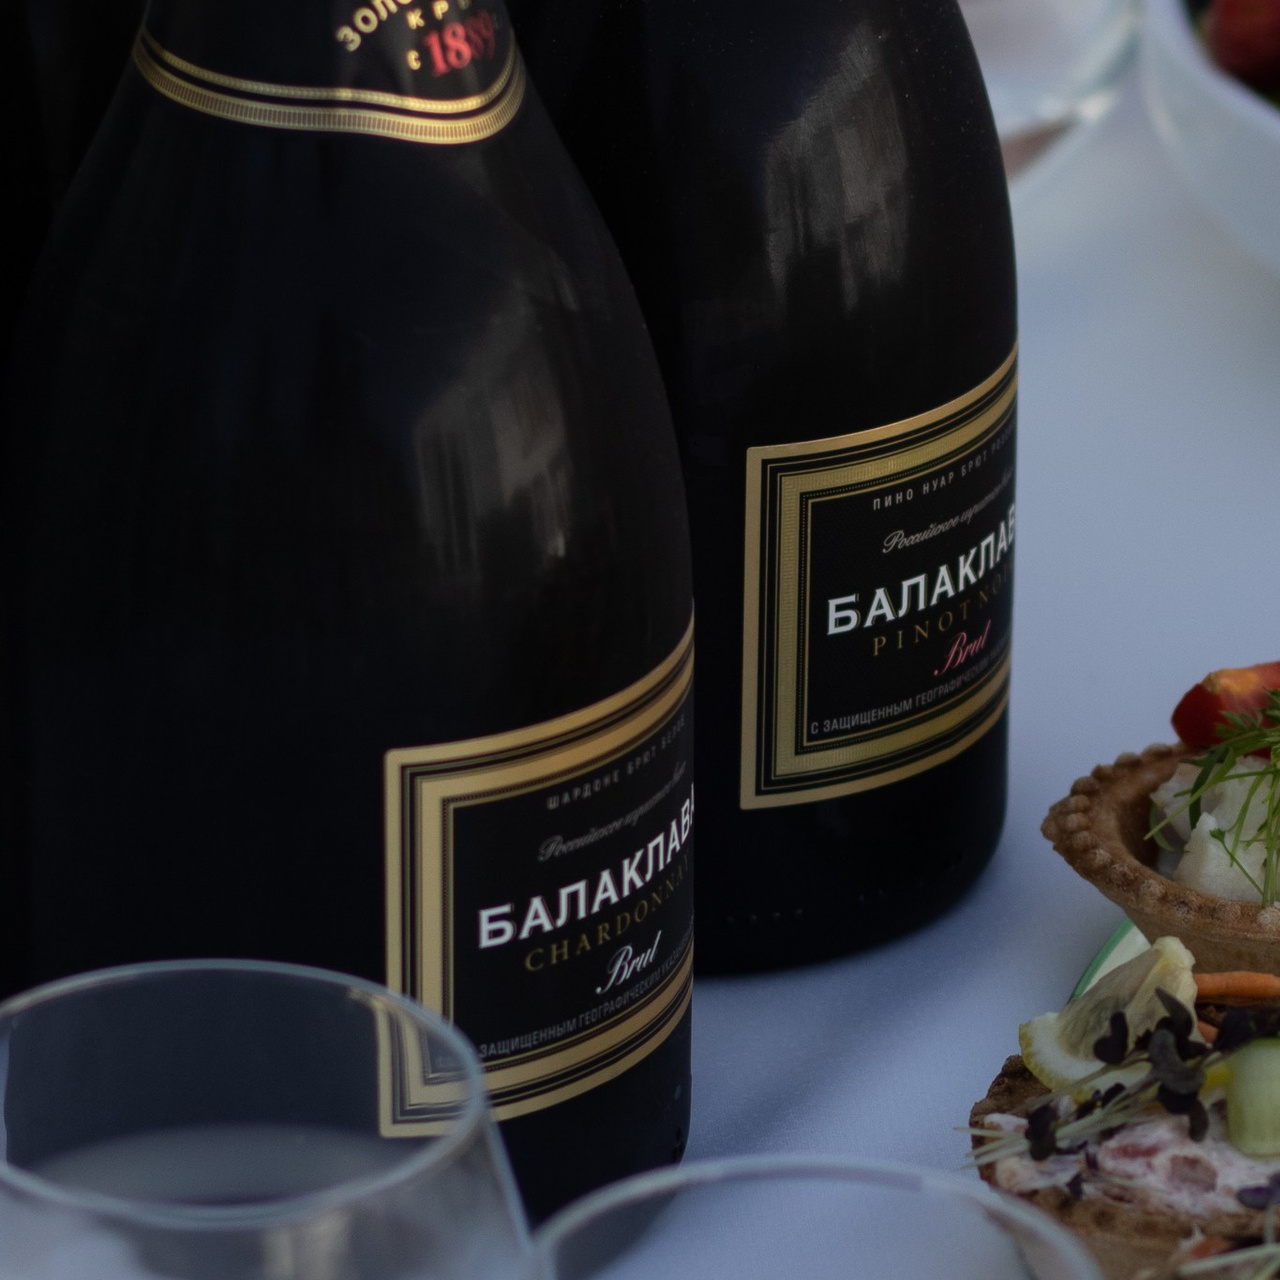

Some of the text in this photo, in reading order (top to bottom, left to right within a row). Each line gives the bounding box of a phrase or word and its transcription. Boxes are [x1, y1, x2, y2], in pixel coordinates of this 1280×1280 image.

[873, 450, 988, 511] ПИНО НУАР БРЮТ
[827, 503, 1015, 636] БАЛАКЛАВ
[873, 598, 971, 656] PINOT
[933, 618, 992, 676] Brut
[823, 698, 913, 732] ЗАЩИЩЕННЫМ
[546, 769, 620, 811] ШАРДОНЕ
[595, 930, 662, 995] Brut
[479, 1018, 577, 1059] ЗАЩИЩЕННЫМ
